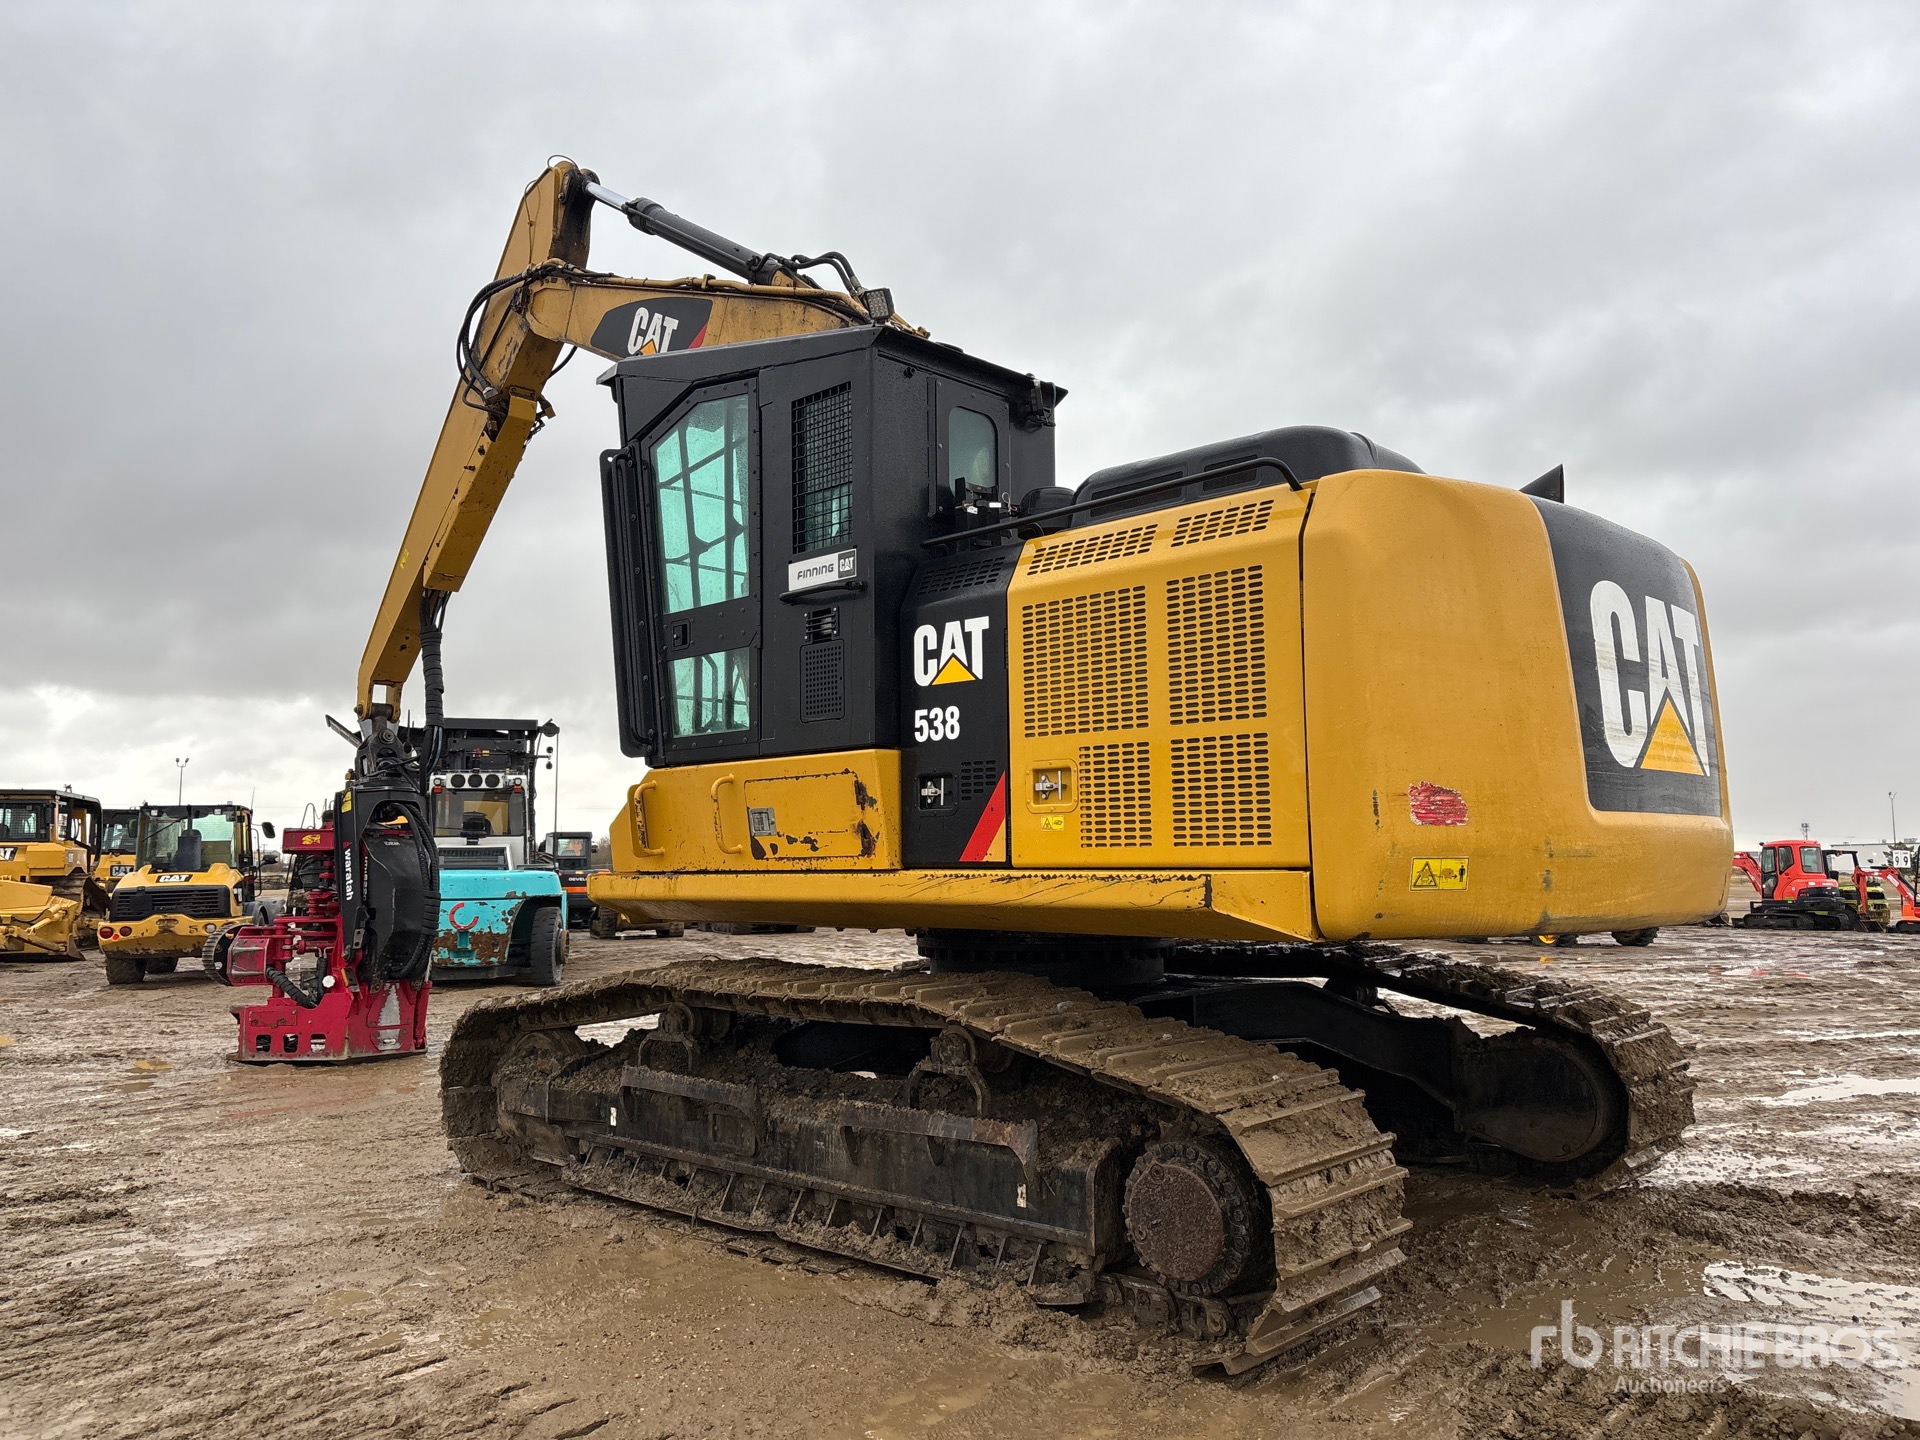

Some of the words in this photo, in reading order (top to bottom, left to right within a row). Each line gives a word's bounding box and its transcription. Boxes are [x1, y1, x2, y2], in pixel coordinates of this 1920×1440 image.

[627, 307, 679, 355] CAT
[797, 563, 834, 580] FINNING
[839, 557, 854, 572] CAT
[914, 616, 990, 686] CAT
[1590, 580, 1710, 777] CAT
[914, 706, 960, 743] 538
[112, 866, 132, 876] CAT
[159, 874, 190, 883] CAT
[344, 848, 355, 901] waratah
